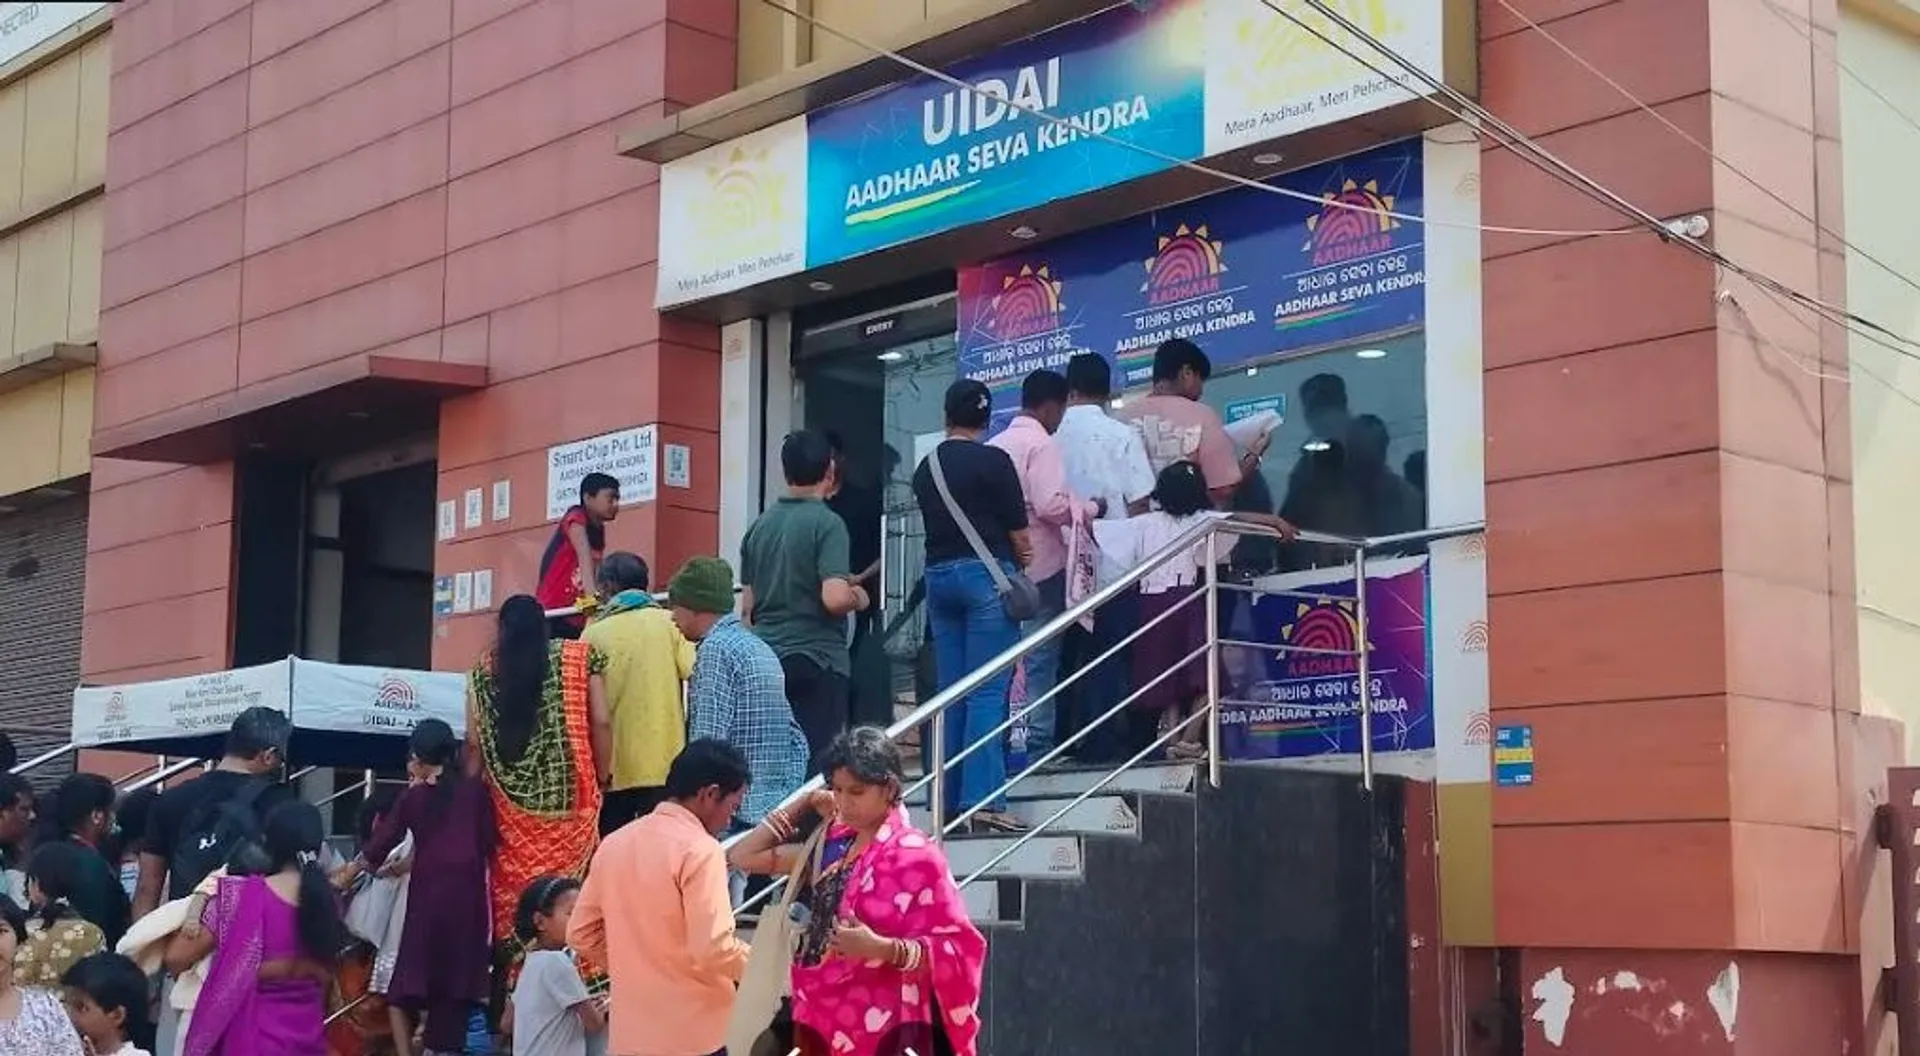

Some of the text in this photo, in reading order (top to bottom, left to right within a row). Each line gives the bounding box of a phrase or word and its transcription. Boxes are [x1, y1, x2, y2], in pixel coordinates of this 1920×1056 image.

[923, 57, 1060, 146] UIDAI
[1224, 115, 1256, 136] Mera
[1259, 101, 1315, 126] Aadhaar,
[1319, 91, 1349, 108] Meri
[845, 95, 1150, 210] AADHAAR SEVA KENDRA
[1274, 291, 1338, 317] AADHAAR
[1340, 283, 1373, 302] SEVA
[865, 320, 894, 335] ENTRY
[1115, 310, 1256, 352] AADHAAR SEVA KENDRA
[1017, 357, 1044, 373] SEVA
[553, 448, 584, 468] Smart
[585, 442, 609, 461] Chip
[634, 431, 652, 450] Ltd
[1288, 656, 1360, 678] AADHAA
[1249, 706, 1312, 722] AADHAAR
[1350, 697, 1408, 716] KNDRA
